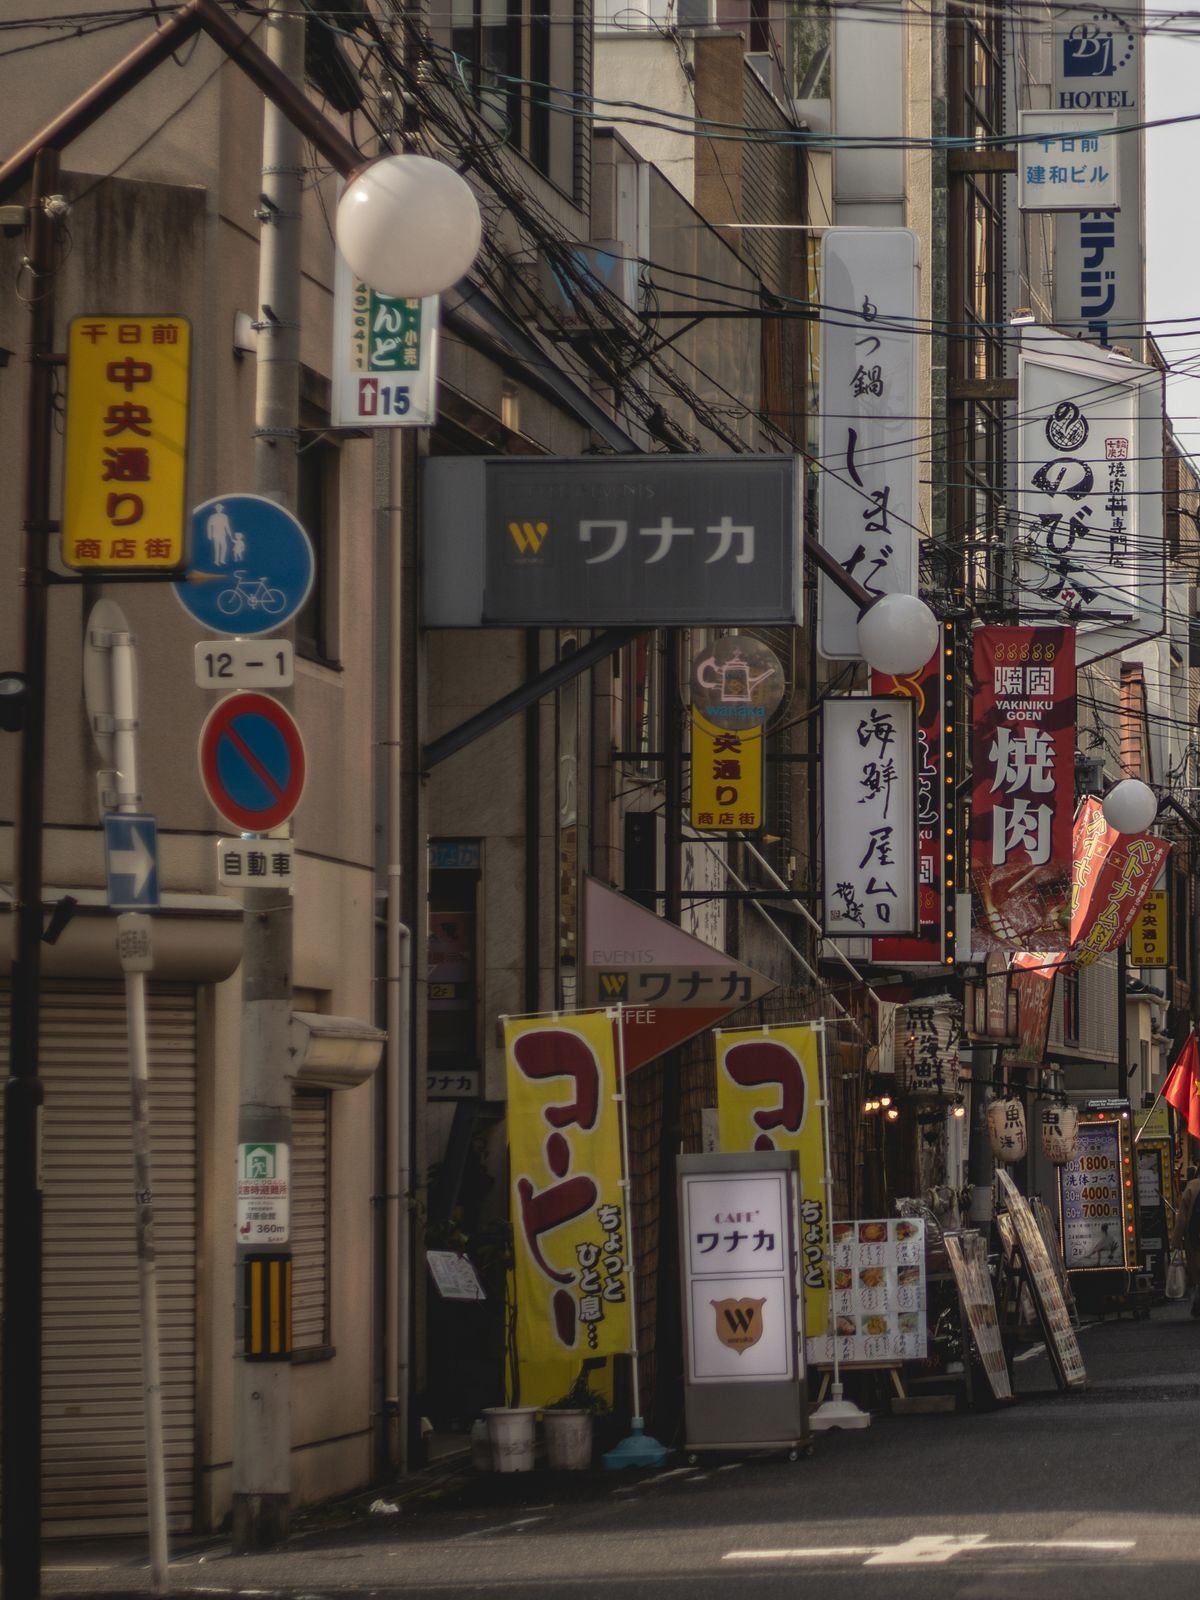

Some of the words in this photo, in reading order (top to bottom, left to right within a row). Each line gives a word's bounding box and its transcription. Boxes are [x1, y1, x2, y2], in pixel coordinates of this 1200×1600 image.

[1059, 90, 1135, 109] HOTEL
[1026, 164, 1109, 184] 建和ビル
[80, 323, 180, 346] 千日前
[371, 290, 402, 366] んど
[381, 386, 411, 416] 15
[101, 357, 153, 527] 中央通り
[73, 538, 173, 561] 商店街
[578, 516, 755, 565] ワナカ
[995, 700, 1054, 711] YAKINIKU
[1006, 710, 1042, 721] GOEN
[988, 726, 1056, 867] 焼肉
[697, 812, 756, 826] 商店街
[224, 852, 292, 877] 自動車
[1142, 901, 1158, 953] 中央通り
[592, 950, 654, 965] EVENTS
[639, 970, 752, 1002] ワナカ
[512, 1029, 600, 1348] コーヒー
[1066, 1173, 1117, 1187] 洗体コース
[257, 1224, 285, 1234] 360m
[697, 1229, 775, 1254] ワナカ
[597, 1204, 626, 1302] ちょっと
[800, 1199, 826, 1289] ちょっと
